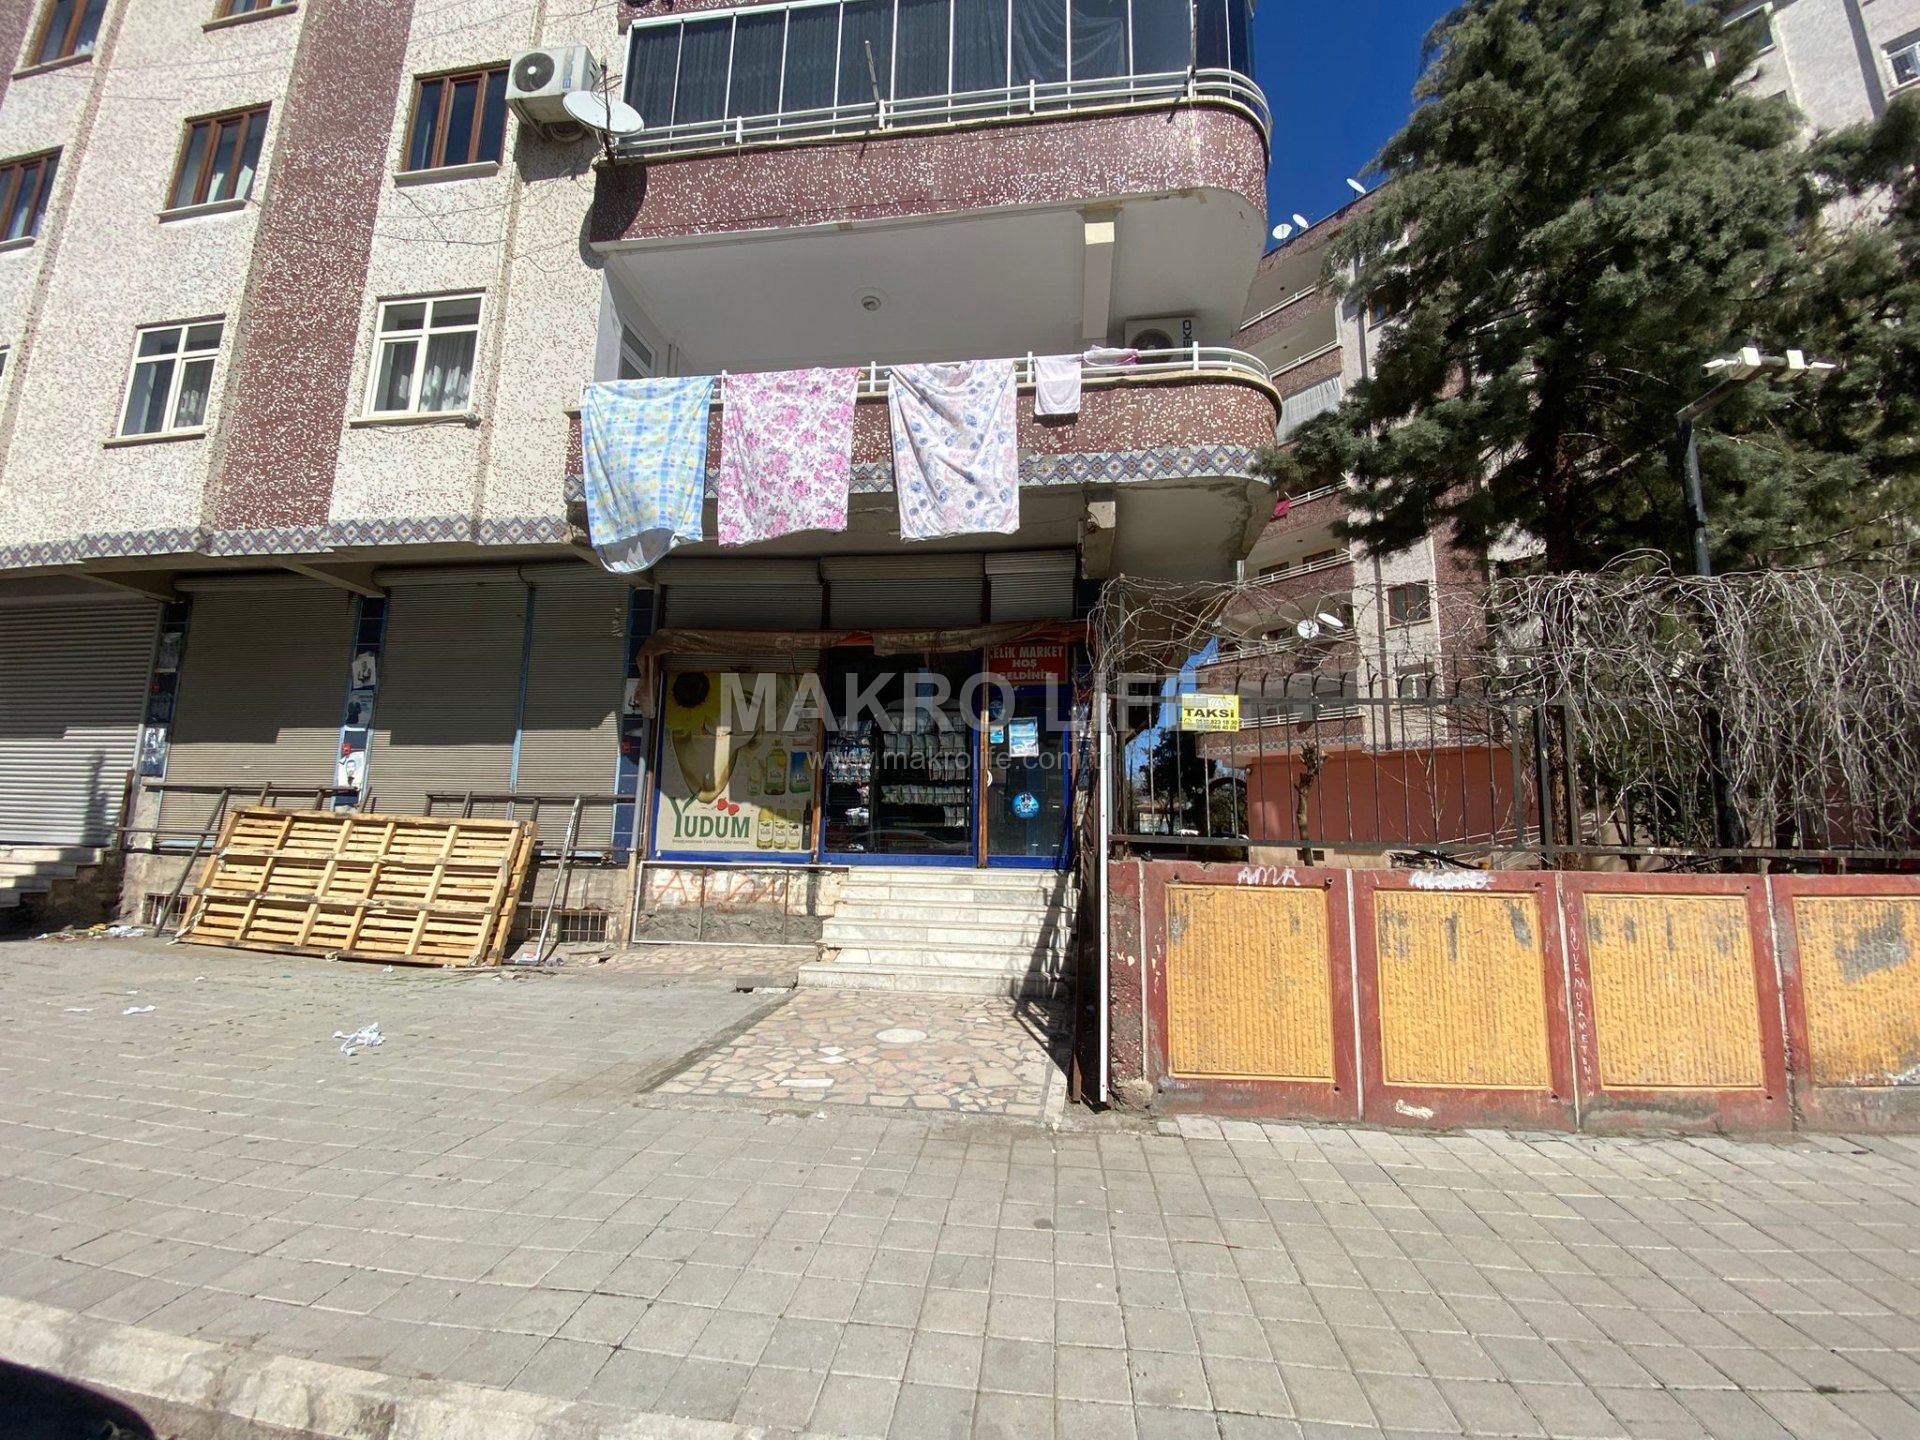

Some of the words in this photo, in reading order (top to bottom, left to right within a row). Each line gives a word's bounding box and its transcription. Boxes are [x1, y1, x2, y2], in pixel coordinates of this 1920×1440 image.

[1020, 645, 1063, 658] MARKET
[1012, 658, 1037, 669] HOŞ
[669, 794, 750, 838] YUDUM
